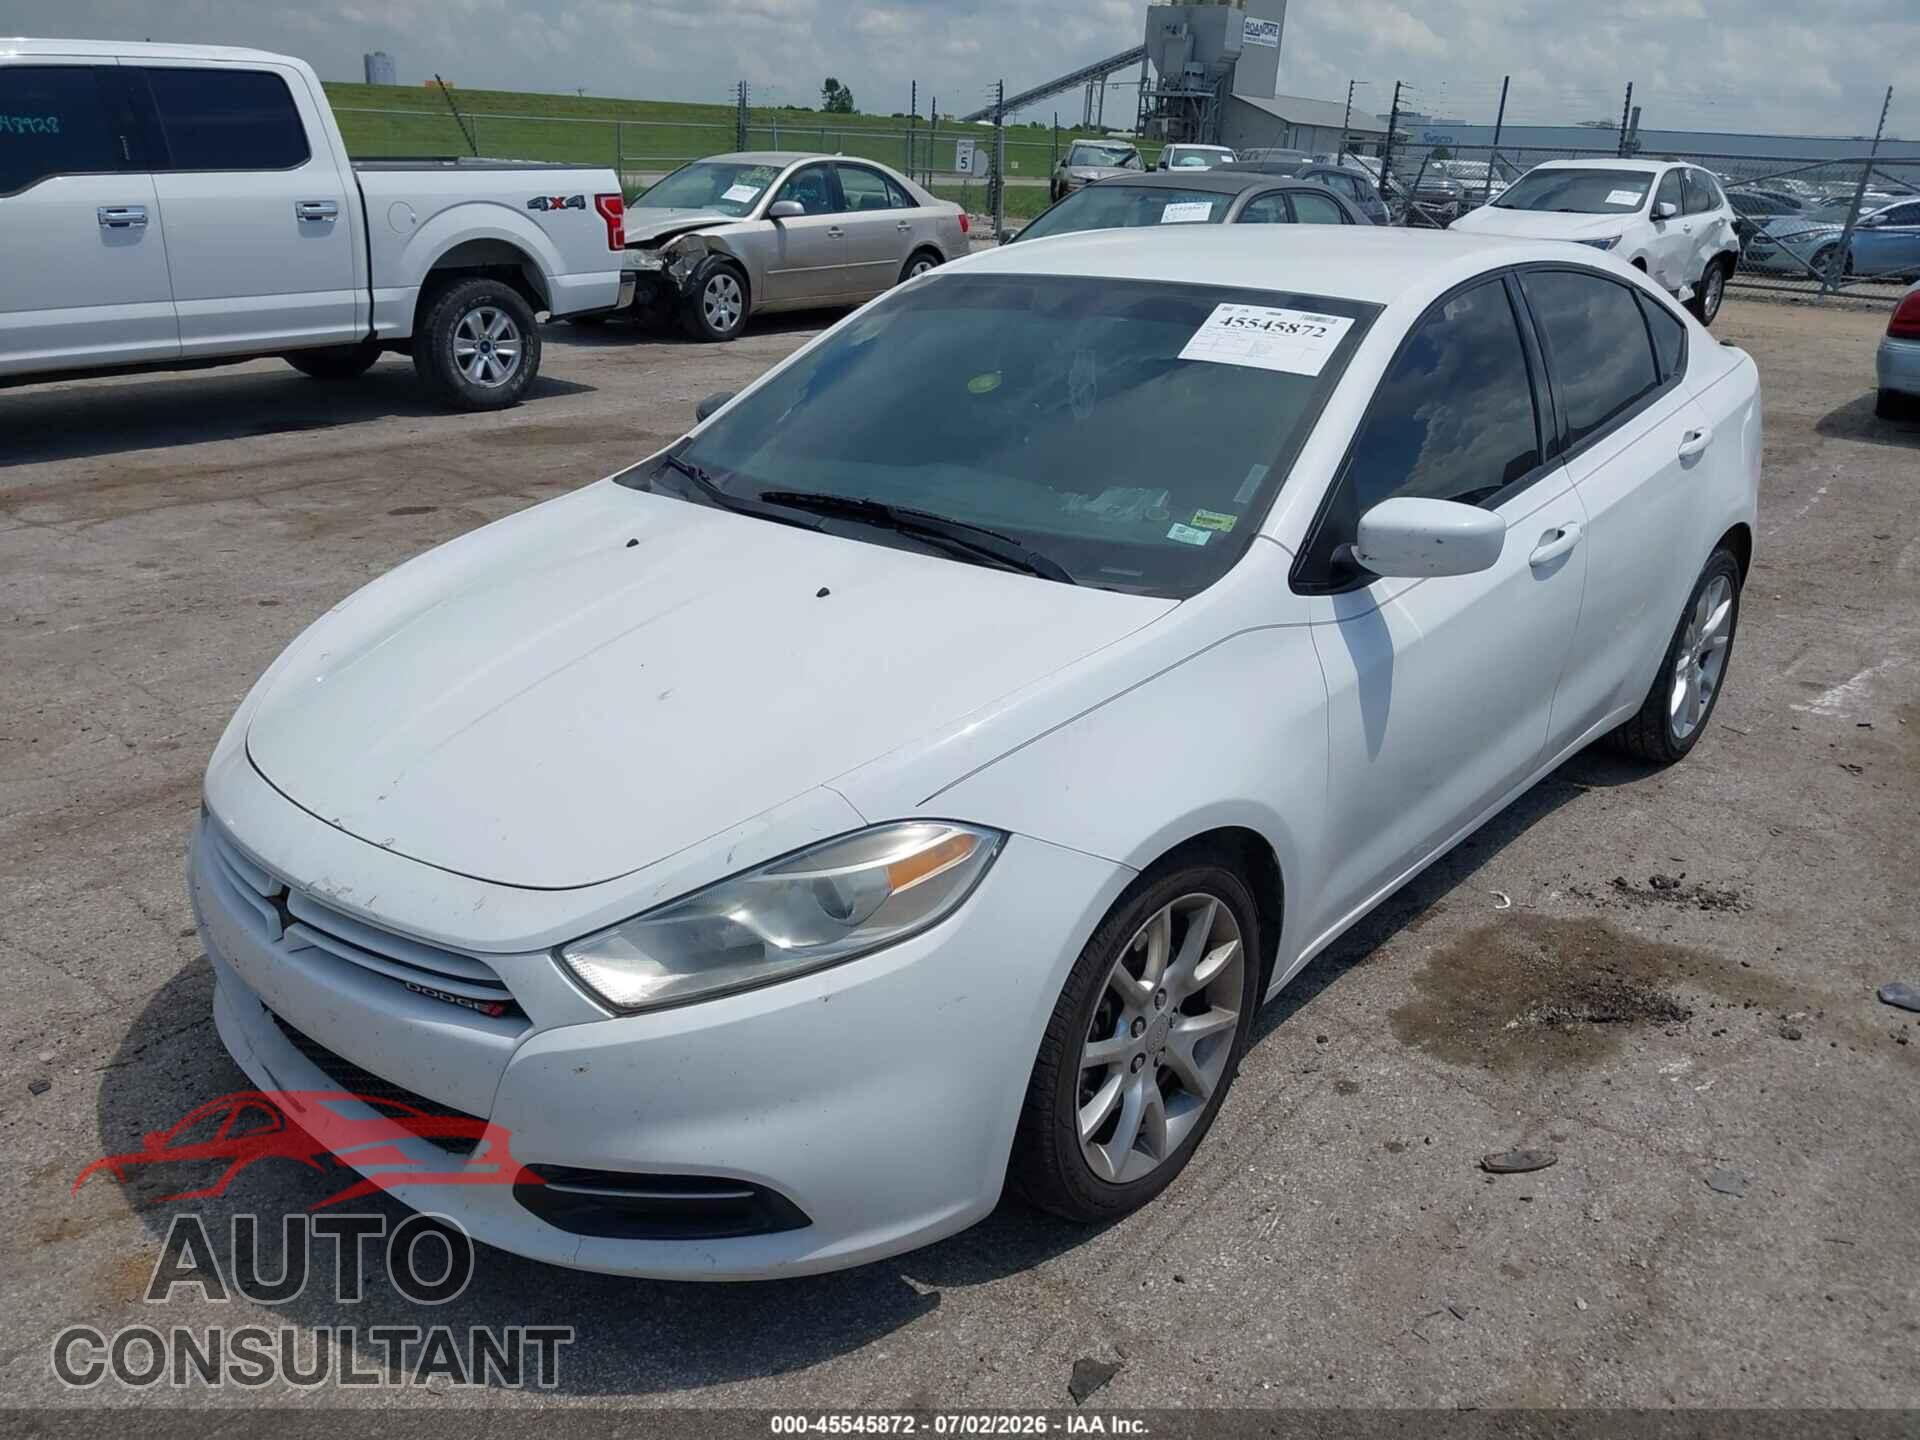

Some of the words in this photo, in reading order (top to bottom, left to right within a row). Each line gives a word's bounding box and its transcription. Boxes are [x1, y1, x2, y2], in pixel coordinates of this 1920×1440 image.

[960, 157, 968, 169] 5
[1219, 315, 1328, 338] 45545872
[405, 982, 490, 1013] DODGE
